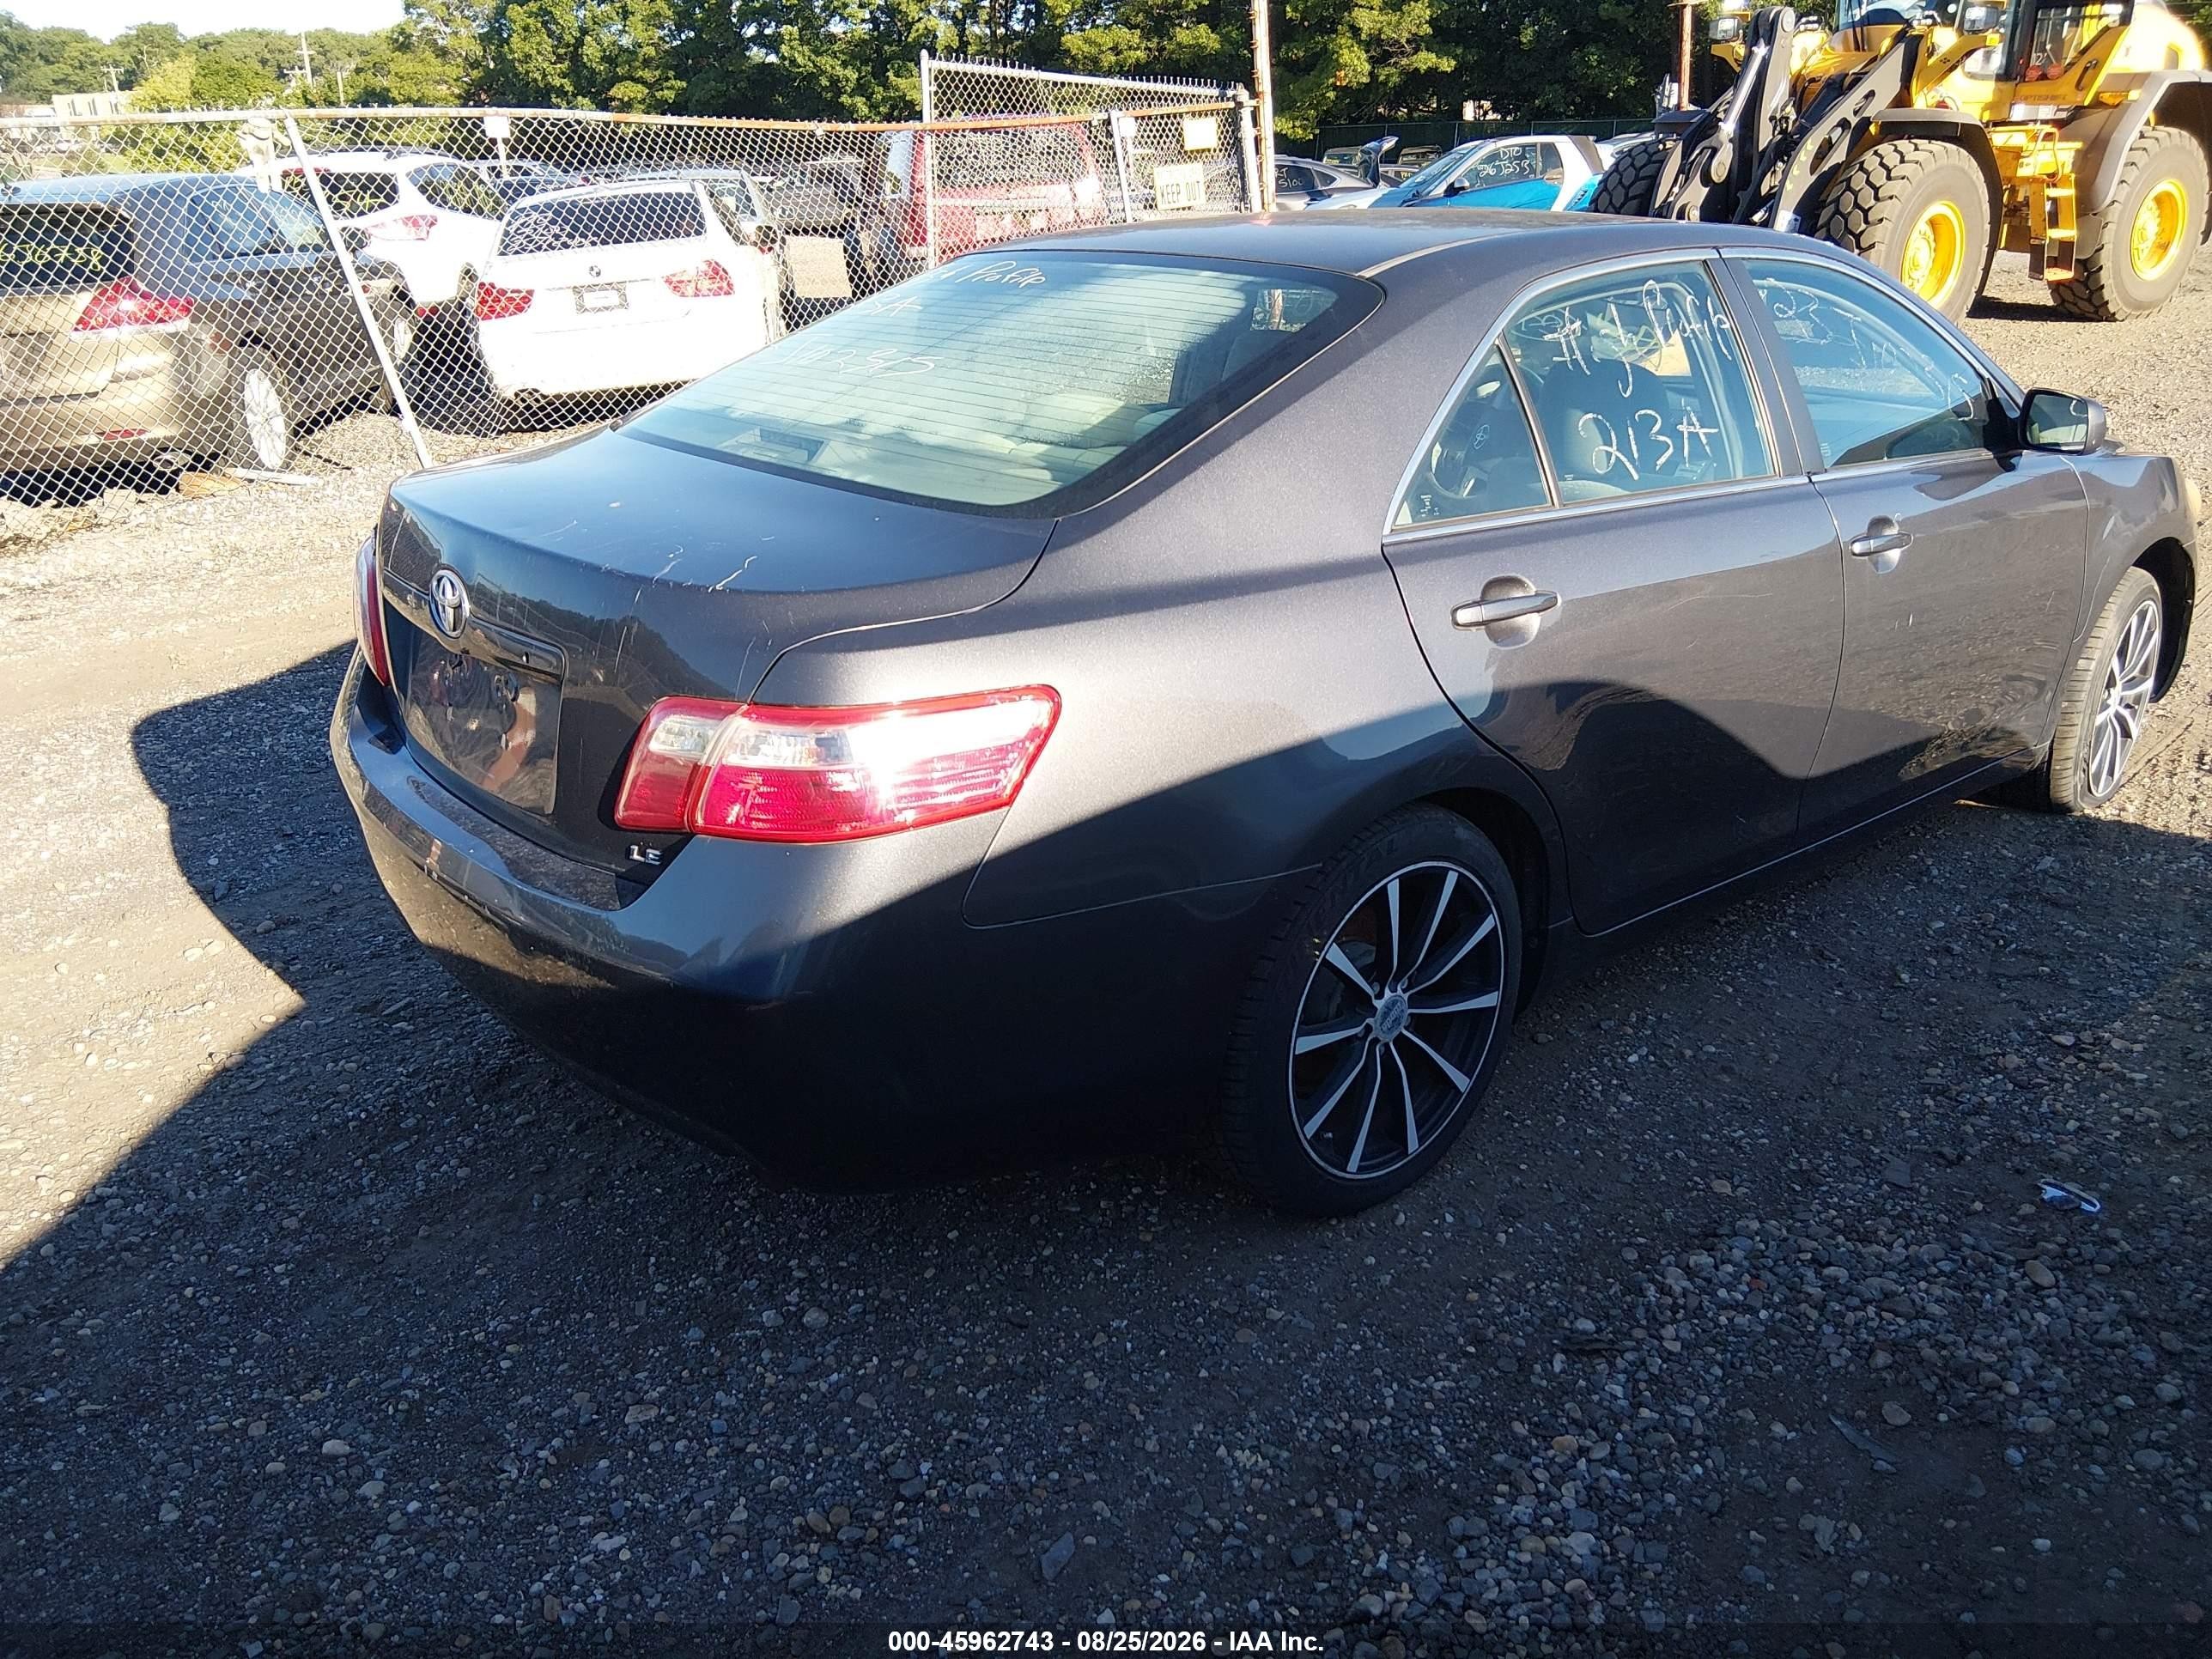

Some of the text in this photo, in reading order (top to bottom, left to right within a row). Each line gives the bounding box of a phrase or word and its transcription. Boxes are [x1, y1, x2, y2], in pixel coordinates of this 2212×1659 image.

[1159, 180, 1200, 204] KEEP OUT
[1577, 398, 1719, 481] 213A
[629, 844, 661, 866] LE
